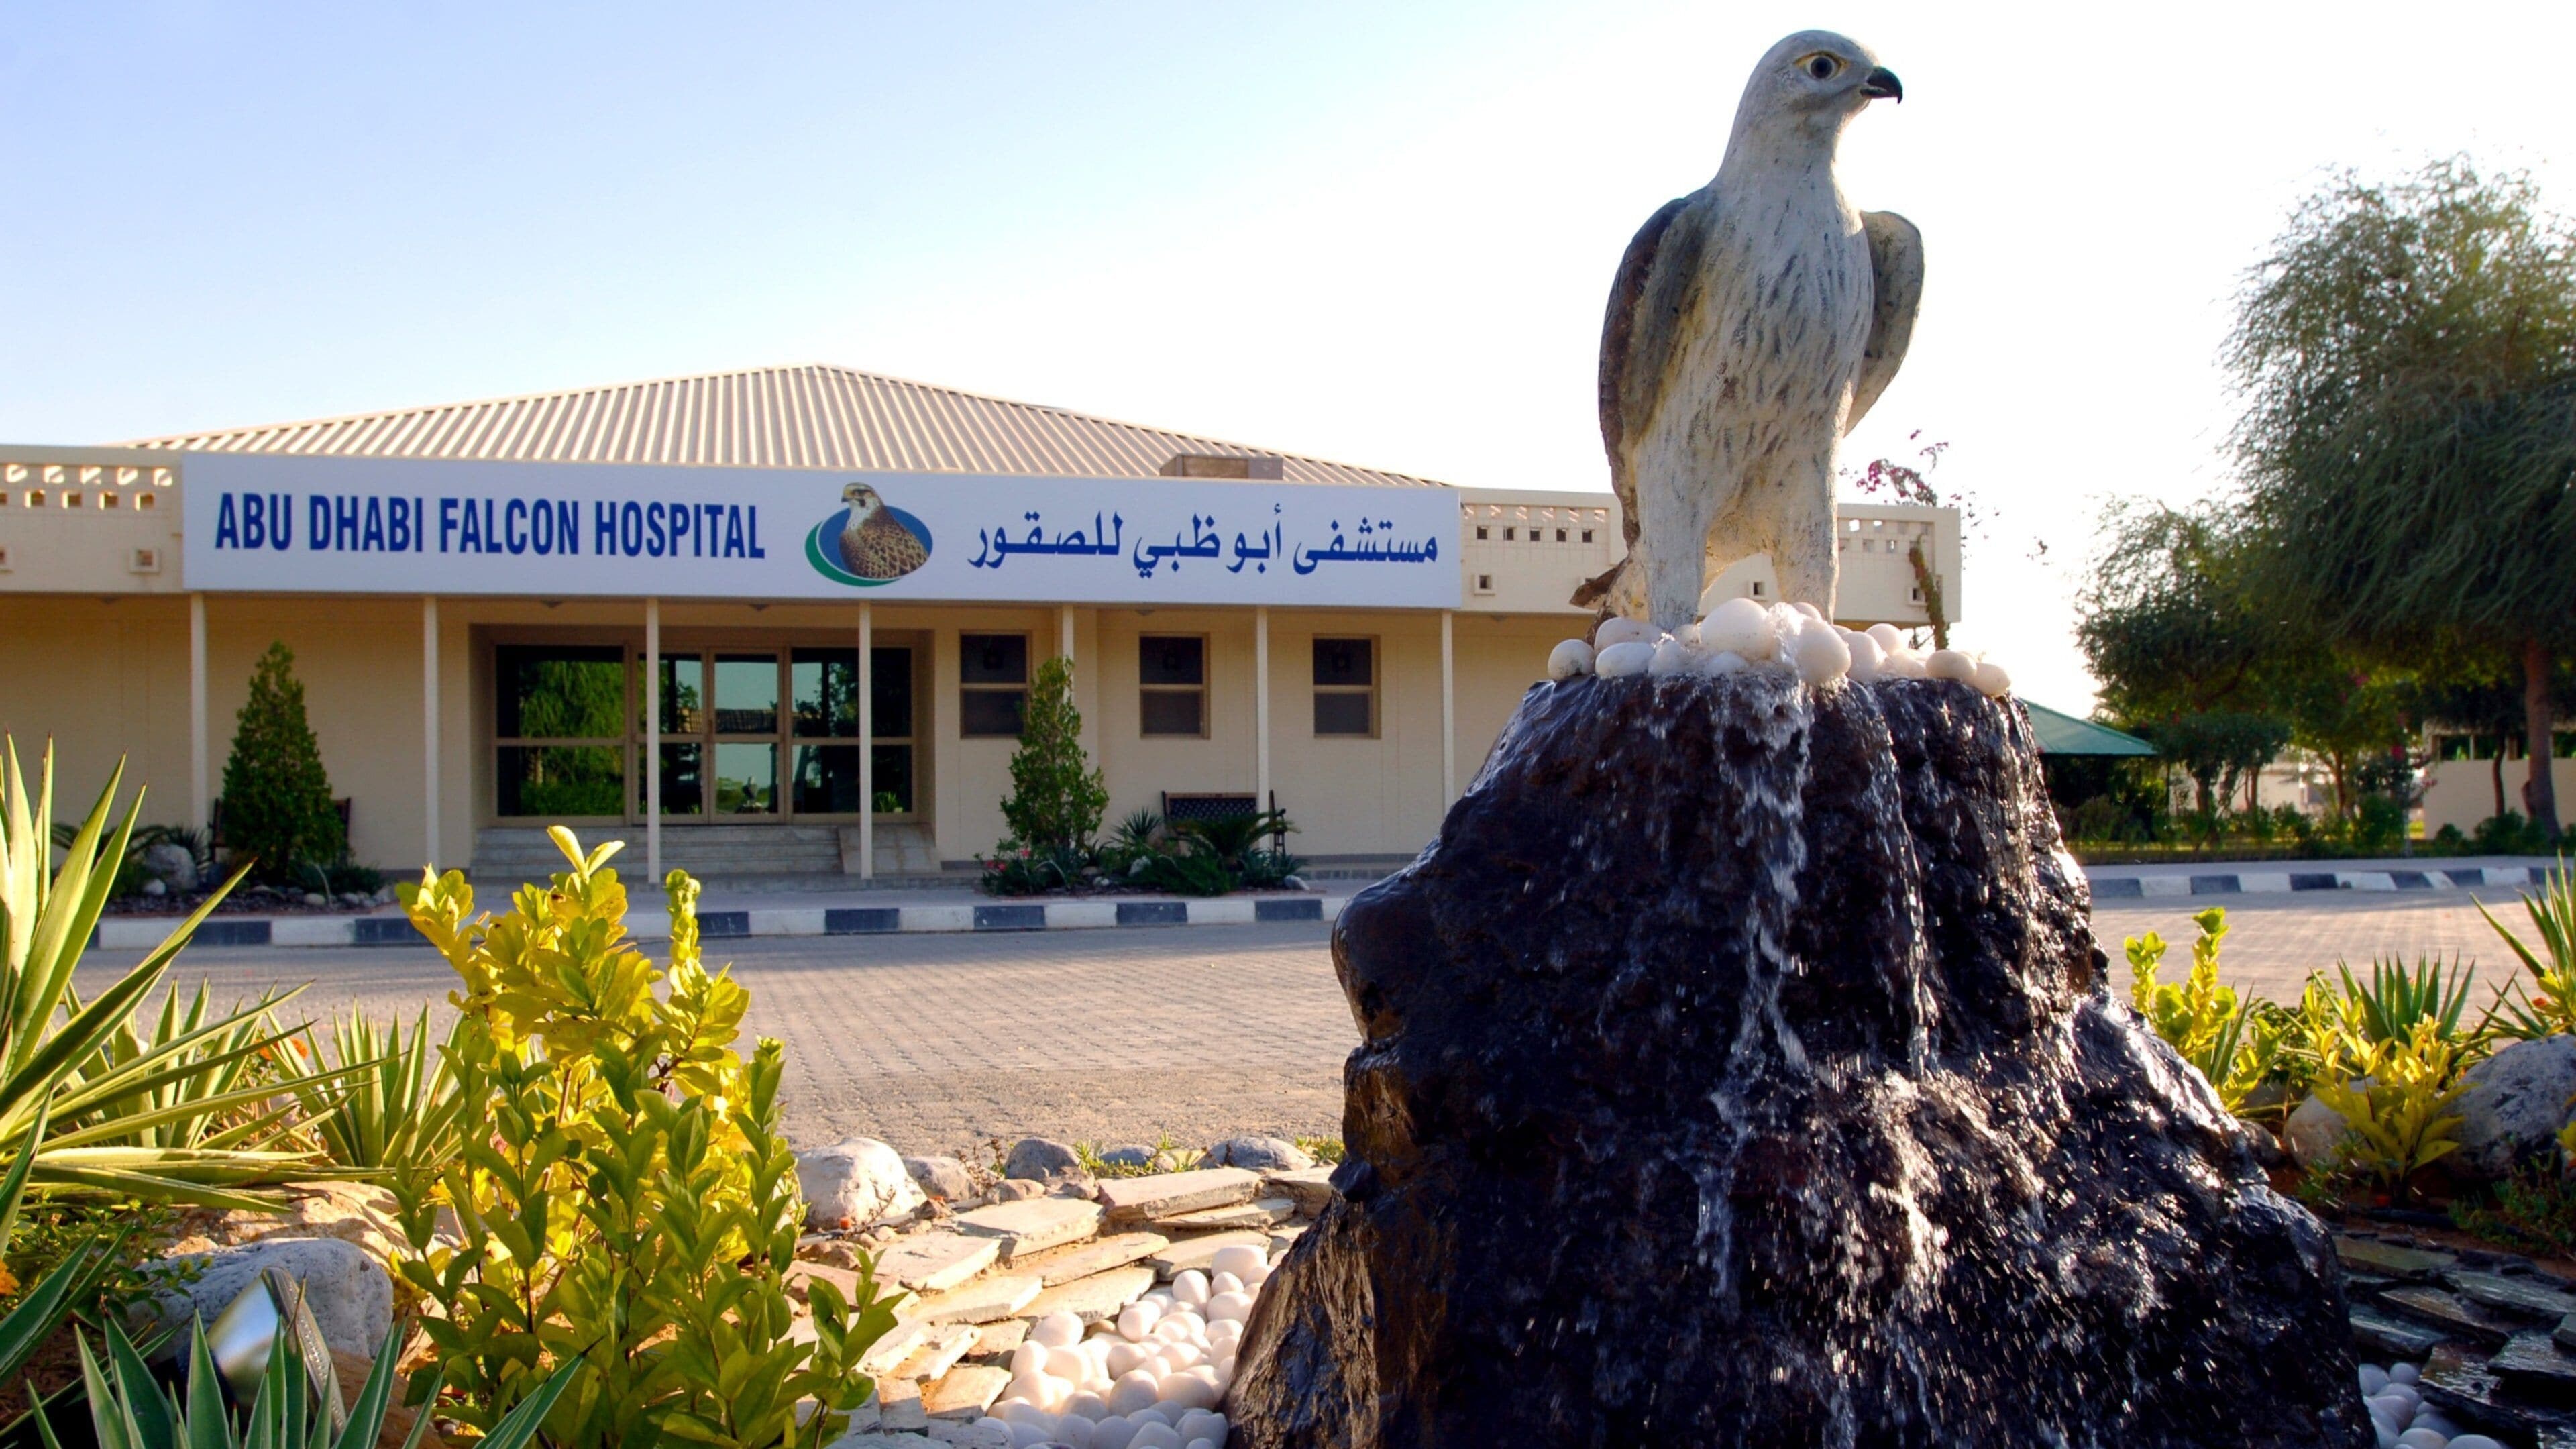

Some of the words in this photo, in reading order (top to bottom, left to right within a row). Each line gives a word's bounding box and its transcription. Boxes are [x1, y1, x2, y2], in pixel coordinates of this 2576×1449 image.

[215, 492, 292, 552] ABU
[309, 494, 423, 553] DHABI
[439, 497, 580, 556] FALCON
[595, 500, 765, 559] HOSPITAL
[967, 510, 1124, 569] للصقور
[1293, 516, 1438, 575] مستشفى
